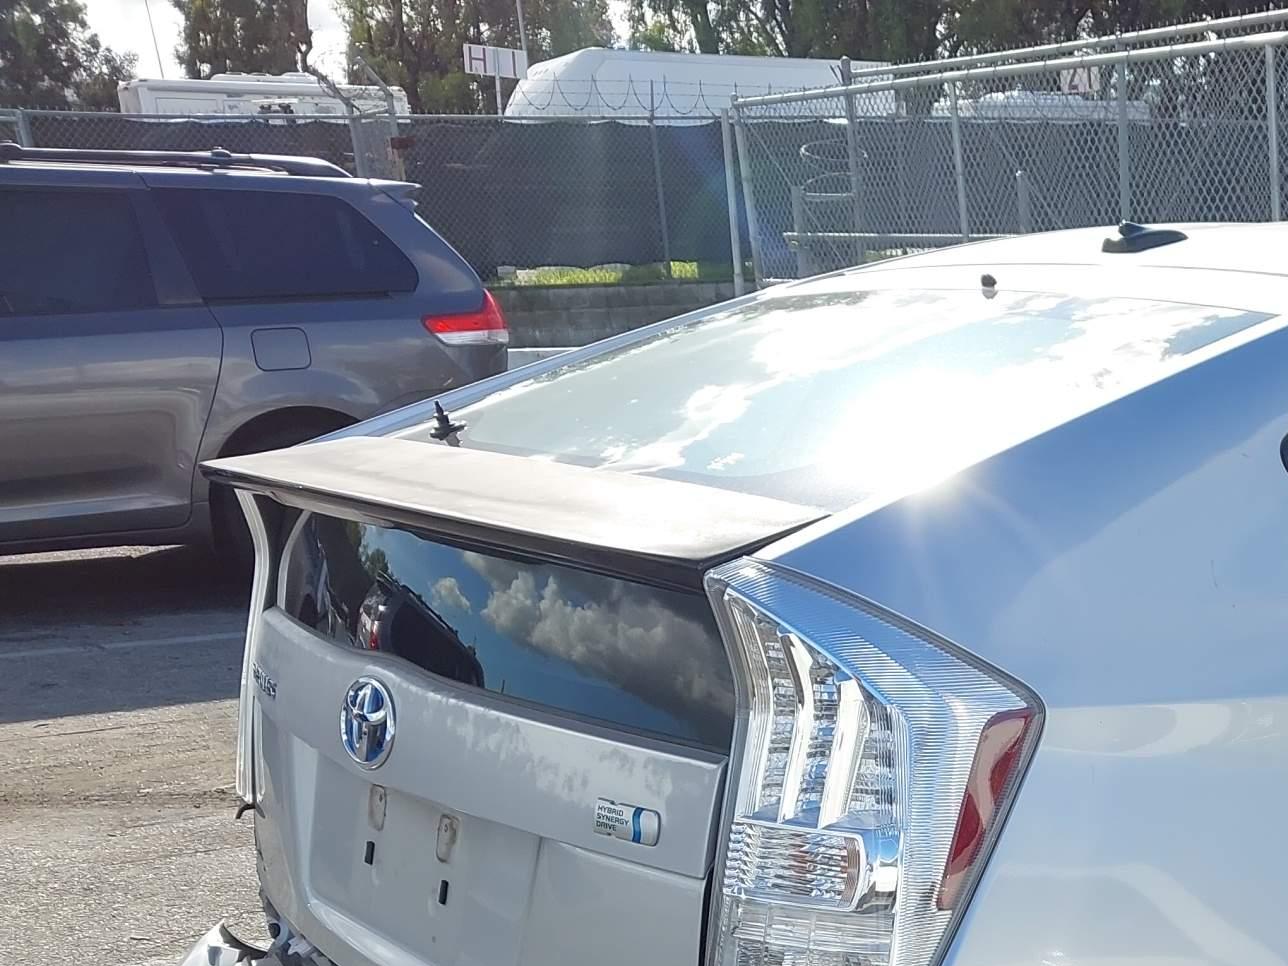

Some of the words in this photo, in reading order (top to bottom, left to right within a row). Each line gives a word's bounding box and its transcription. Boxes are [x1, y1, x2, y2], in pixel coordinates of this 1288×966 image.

[597, 805, 624, 817] HYBRID
[596, 812, 630, 827] SYNERGY
[595, 820, 617, 832] DRIVE
